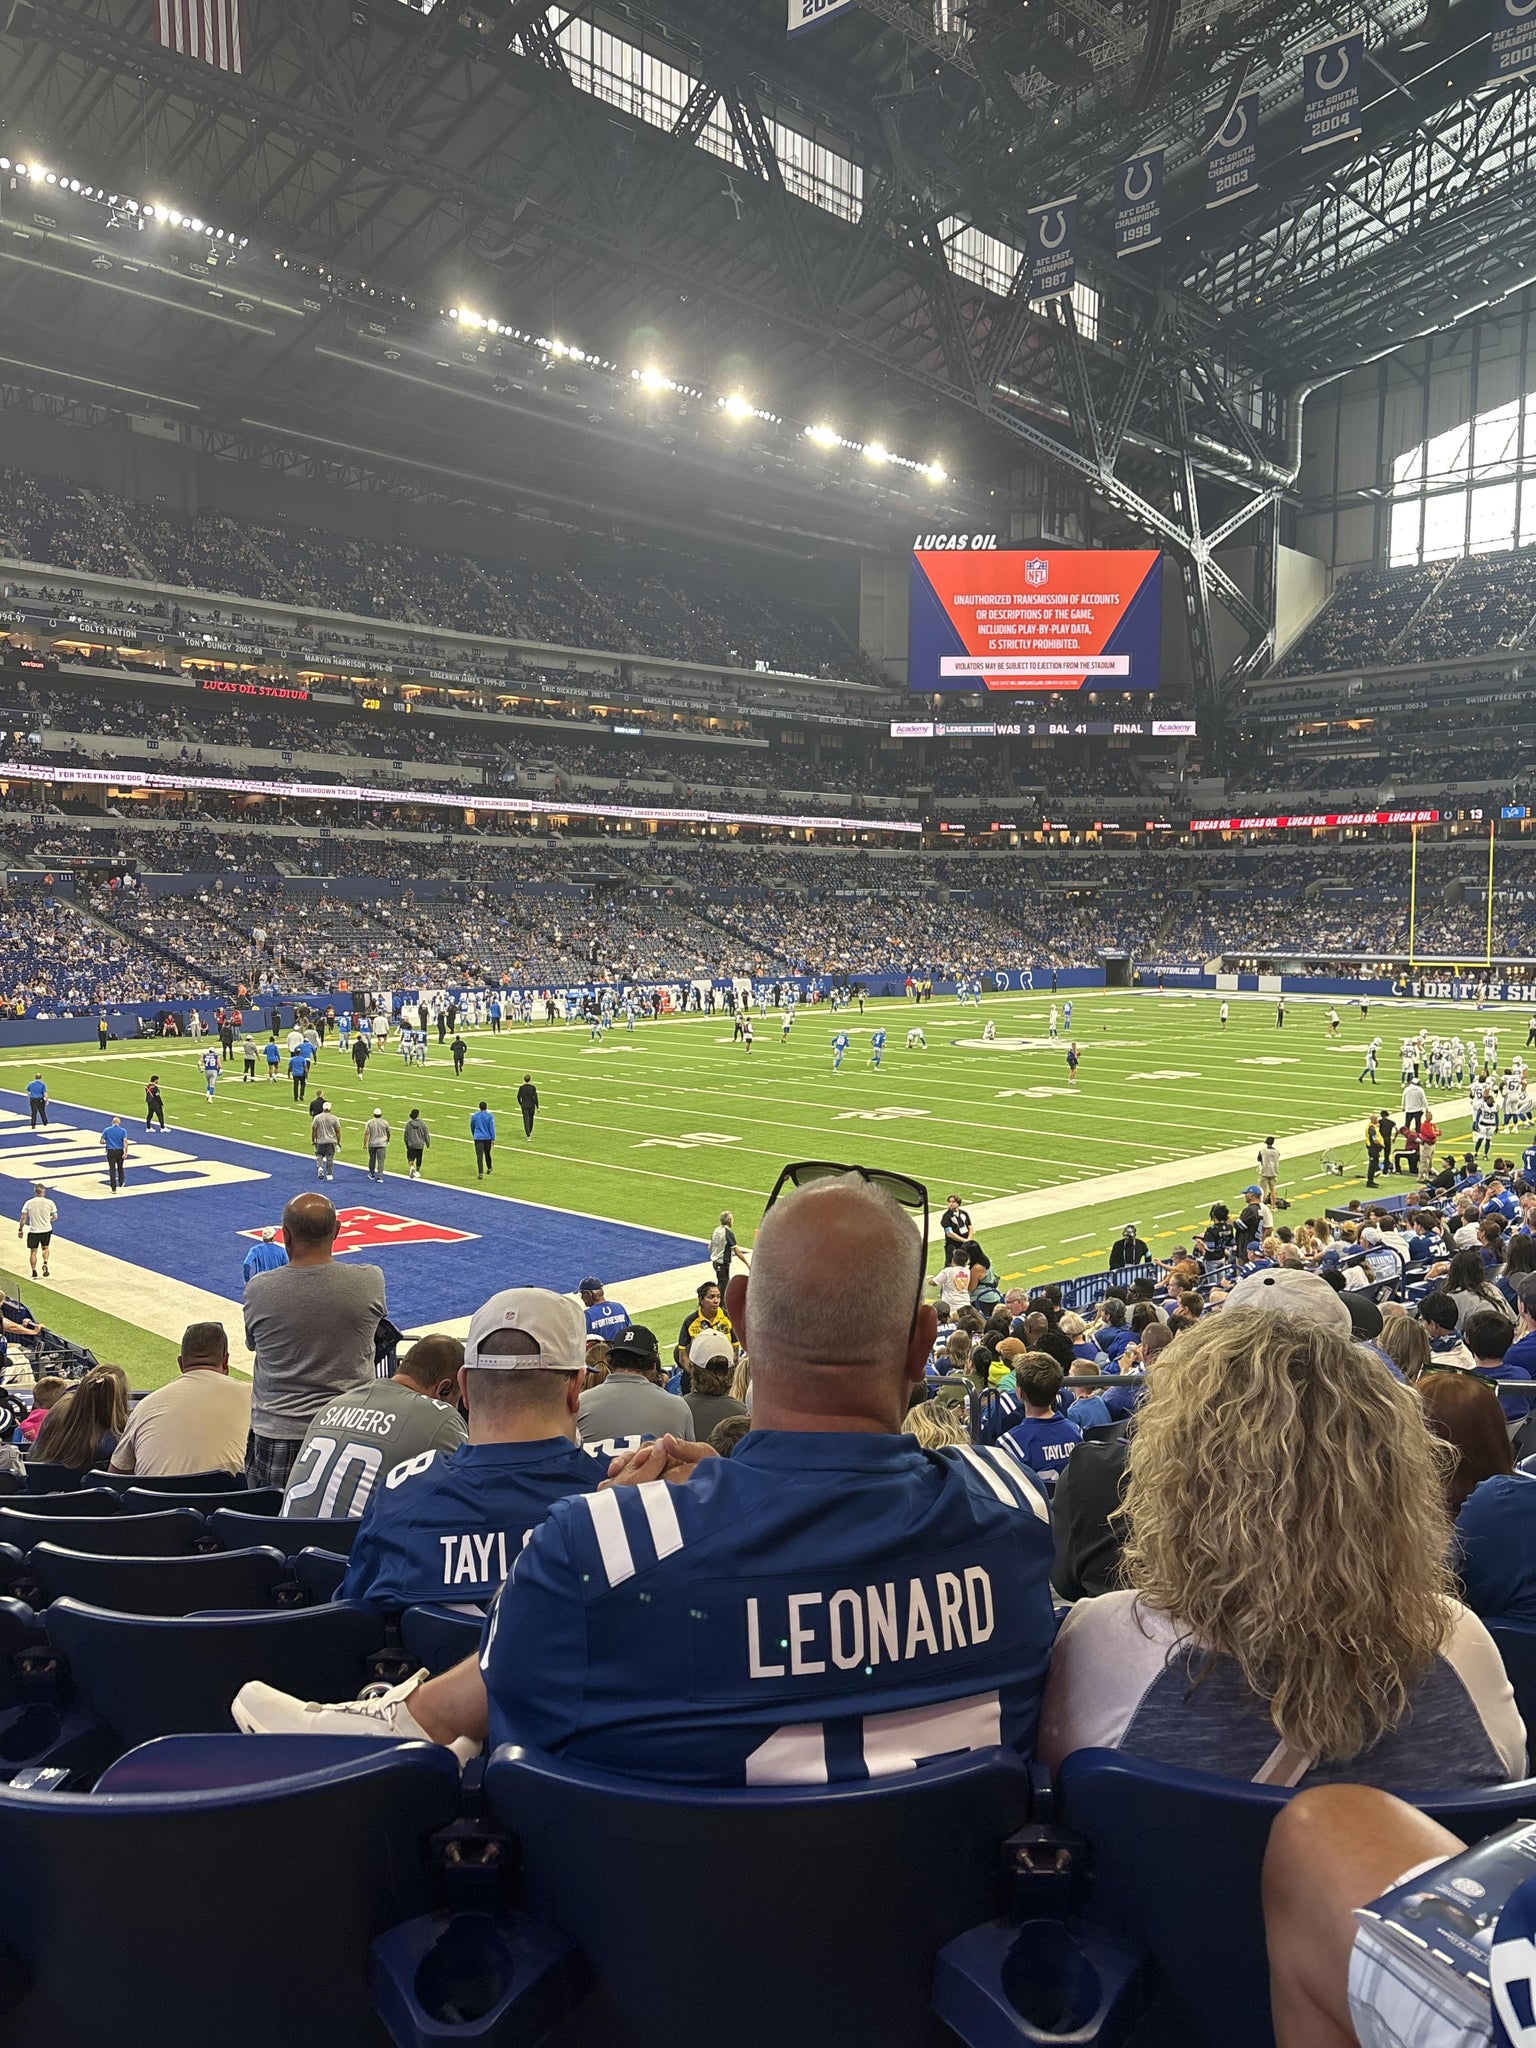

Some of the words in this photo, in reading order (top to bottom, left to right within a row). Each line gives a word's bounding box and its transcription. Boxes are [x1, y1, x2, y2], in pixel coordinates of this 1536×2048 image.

[1494, 28, 1514, 41] AFC
[1306, 100, 1323, 113] AFC
[1326, 87, 1358, 105] SOUTH
[1304, 96, 1359, 123] CHAMPIONS
[1312, 112, 1350, 137] 2004
[1209, 157, 1226, 169] AFC
[1227, 144, 1255, 161] SOUTH
[1207, 153, 1256, 179] CHAMPIONS
[1216, 169, 1248, 193] 2003
[1118, 207, 1135, 219] AFC
[1135, 200, 1156, 217] EAST
[1115, 208, 1160, 230] CHAMPIONS
[1123, 223, 1151, 242] 1999
[1036, 255, 1051, 267] AFC
[1052, 250, 1071, 263] EAST
[1032, 257, 1074, 277] CHAMPIONS
[1040, 271, 1067, 290] 1987
[913, 534, 968, 550] LUCAS
[971, 534, 997, 550] OIL
[954, 594, 1011, 605] UNAUTHORIZED
[1013, 594, 1068, 605] TRANSMISSION
[1070, 594, 1078, 604] OF
[1081, 594, 1120, 605] ACCOUNTS
[0, 612, 26, 623] 94-97
[976, 609, 987, 619] OR
[988, 609, 1042, 619] DESCRIPTIONS
[1043, 609, 1053, 619] OF
[1055, 609, 1069, 619] THE
[1071, 608, 1095, 620] GAME,
[79, 623, 105, 634] COLTS
[107, 625, 137, 639] NATION
[978, 624, 1016, 634] INCLUDING
[1018, 624, 1070, 634] PLAY-BY-PLAY
[1071, 624, 1092, 635] DATA,
[185, 639, 205, 647] TONY
[207, 641, 232, 651] DUNGY
[235, 645, 263, 655] 2002-08
[989, 639, 997, 649] IS
[997, 639, 1032, 649] STRICTLY
[1032, 639, 1080, 649] PROHIBITED.
[20, 660, 44, 669] verizon
[304, 655, 332, 665] MARVIN
[333, 657, 366, 669] HARRISON
[955, 662, 984, 670] VIOLATORS
[985, 662, 997, 670] MAY
[1006, 662, 1028, 670] SUBJECT
[1037, 661, 1062, 669] EJECTION
[1063, 661, 1079, 669] FROM
[1091, 661, 1115, 669] STADIUM
[460, 674, 480, 685] JAMES
[203, 680, 236, 693] LUCAS
[239, 684, 257, 695] OIL
[259, 687, 308, 700] STADIUM
[542, 685, 556, 693] ERIC
[557, 686, 588, 697] DICKERSON
[1466, 695, 1493, 705] DWIGHT
[1495, 692, 1527, 702] FREENEY
[405, 703, 411, 714] 3
[1355, 706, 1378, 714] ROBERT
[1379, 704, 1402, 713] MATHIS
[896, 725, 928, 733] Academy
[946, 725, 971, 733] LEAGUE
[972, 725, 994, 733] STATS
[997, 724, 1020, 734] WAS
[1028, 724, 1036, 734] 3
[1049, 724, 1070, 734] BAL
[1075, 724, 1087, 734] 41
[1113, 724, 1143, 734] FINAL
[1158, 724, 1191, 732] Academy
[58, 771, 75, 779] FOR
[110, 773, 125, 781] HOT
[296, 787, 336, 795] TOUCHDOWN
[337, 788, 357, 796] TACOS
[474, 799, 502, 807] FOOTLONG
[1336, 814, 1363, 824] LUCAS
[1364, 813, 1378, 823] OIL
[1388, 812, 1416, 821] LUCAS
[1417, 811, 1431, 821] OIL
[1470, 809, 1483, 819] 13
[1195, 821, 1218, 829] LUCAS
[1219, 820, 1231, 828] OIL
[1240, 819, 1264, 828] LUCAS
[1265, 818, 1278, 827] OIL
[1287, 817, 1313, 827] LUCAS
[1314, 816, 1326, 825] OIL
[1412, 981, 1451, 998] FOR
[204, 1058, 216, 1067] 78
[1509, 1080, 1520, 1090] 67
[642, 1132, 743, 1149] 10
[319, 1406, 396, 1435] SANDERS
[279, 1436, 383, 1518] 20
[746, 1566, 995, 1679] LEONARD
